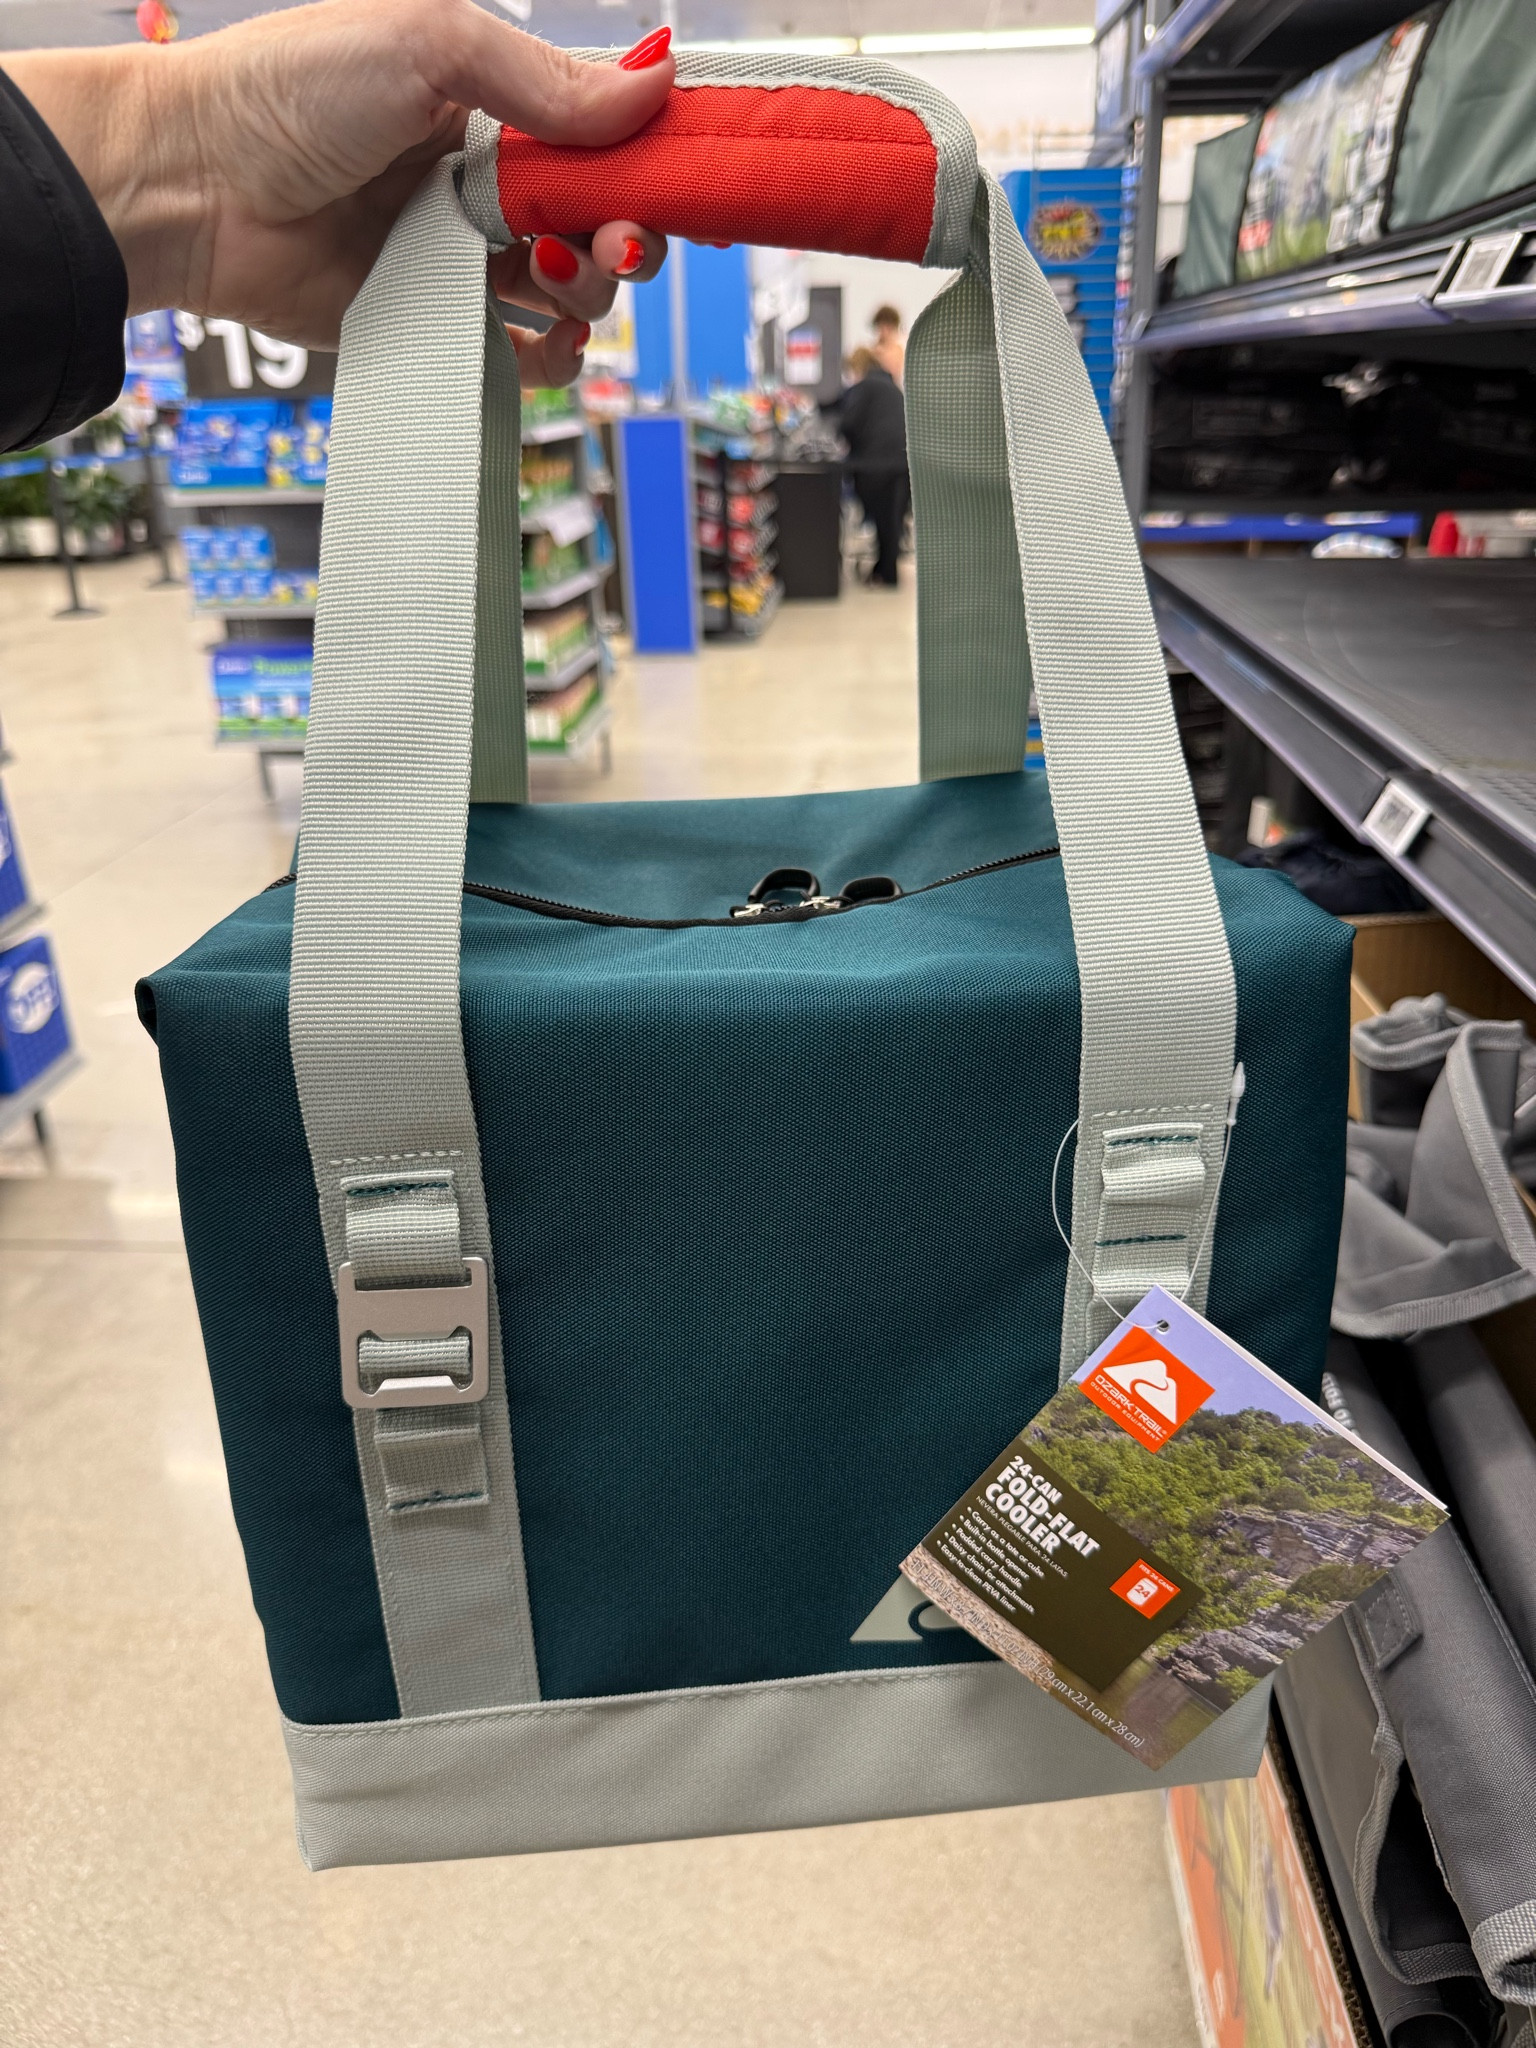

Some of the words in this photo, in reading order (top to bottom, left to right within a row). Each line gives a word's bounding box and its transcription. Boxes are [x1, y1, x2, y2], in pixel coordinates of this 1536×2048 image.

[1090, 1381, 1121, 1409] OUTDOOR
[1122, 1409, 1161, 1441] EQUIPMENT
[1095, 1374, 1134, 1411] OZARK
[996, 1465, 1101, 1558] FOLD-FLAT
[1009, 1455, 1063, 1505] 24-CAN
[963, 1518, 987, 1544] Built-in
[986, 1539, 1006, 1560] bottle
[1005, 1557, 1030, 1579] opener
[971, 1511, 992, 1531] Carry
[990, 1529, 1001, 1540] as
[999, 1537, 1007, 1545] a
[1005, 1542, 1020, 1557] tote
[1019, 1554, 1029, 1564] or
[1027, 1560, 1045, 1578] cube
[976, 1495, 999, 1520] NEVERA
[998, 1517, 1026, 1543] PLEGABLE
[1025, 1540, 1041, 1556] PARA
[1041, 1553, 1051, 1564] 24
[1049, 1560, 1068, 1578] LATAS
[985, 1482, 1062, 1555] COOLER
[940, 1543, 984, 1585] Easy-to-clean
[982, 1581, 1001, 1600] PEVA
[999, 1595, 1017, 1613] liner
[948, 1535, 968, 1556] Daisy
[966, 1553, 987, 1573] chain
[984, 1567, 997, 1580] for
[995, 1579, 1036, 1614] attachments
[956, 1527, 983, 1554] Padded
[980, 1550, 1000, 1570] carry
[999, 1565, 1023, 1588] handle
[1134, 1584, 1150, 1598] 24
[1036, 1664, 1056, 1681] (29
[1051, 1678, 1068, 1693] cm
[1065, 1688, 1075, 1698] x
[1071, 1691, 1095, 1711] 22.1
[1091, 1708, 1108, 1723] cm
[1105, 1717, 1115, 1727] x
[1111, 1720, 1128, 1735] 28
[1124, 1732, 1145, 1748] cm)
